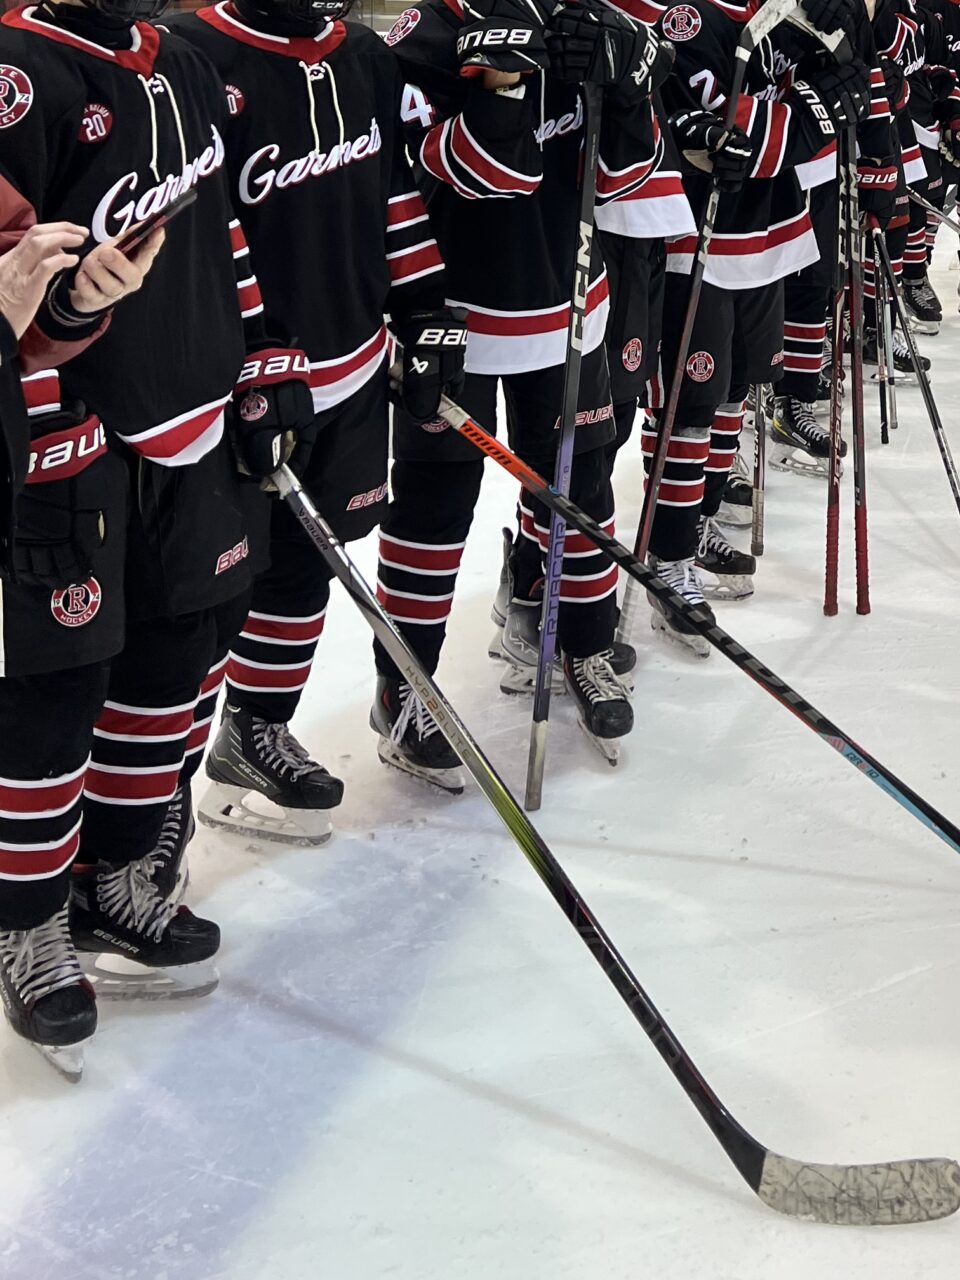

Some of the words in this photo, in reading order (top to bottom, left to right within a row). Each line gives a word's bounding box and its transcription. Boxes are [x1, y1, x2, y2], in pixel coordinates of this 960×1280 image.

[675, 14, 690, 31] R
[82, 114, 107, 141] 20
[68, 587, 87, 612] R
[60, 609, 93, 624] HOCKEY
